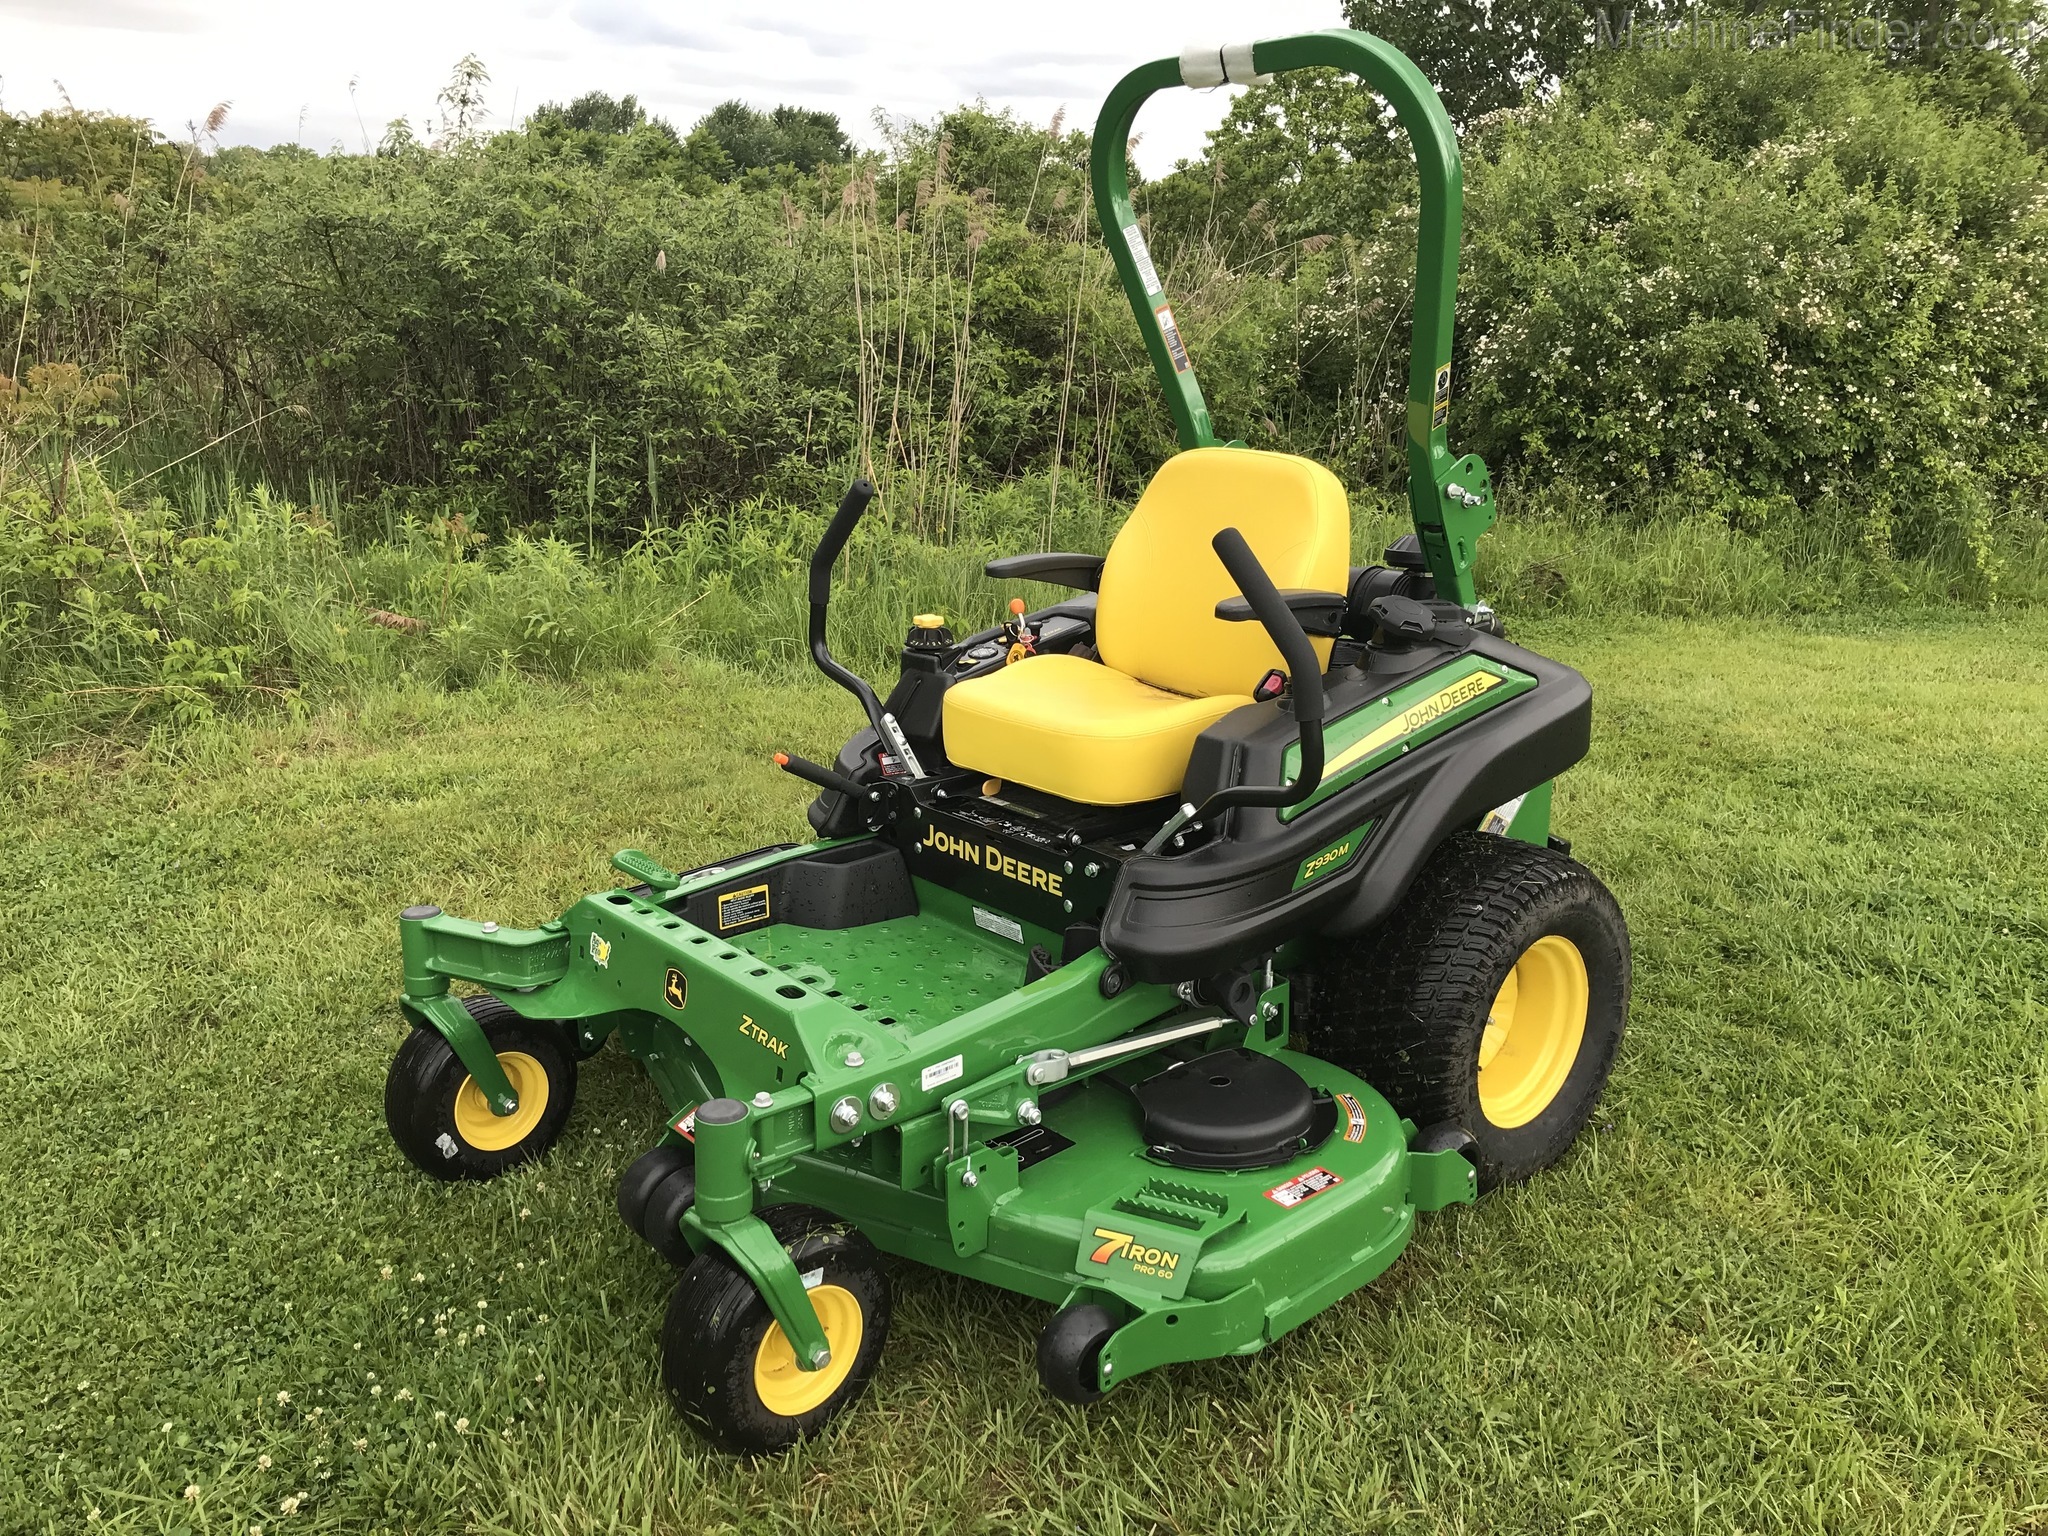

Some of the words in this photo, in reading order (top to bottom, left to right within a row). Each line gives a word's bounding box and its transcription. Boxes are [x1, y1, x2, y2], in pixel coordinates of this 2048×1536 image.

[1402, 700, 1440, 734] JOHN
[1440, 677, 1485, 709] DEERE
[922, 824, 980, 866] JOHN
[985, 845, 1063, 898] DEERE
[1303, 842, 1350, 879] Z930M
[738, 1013, 790, 1060] ZTRAK
[1132, 1263, 1156, 1276] PRO
[1157, 1269, 1174, 1280] 60
